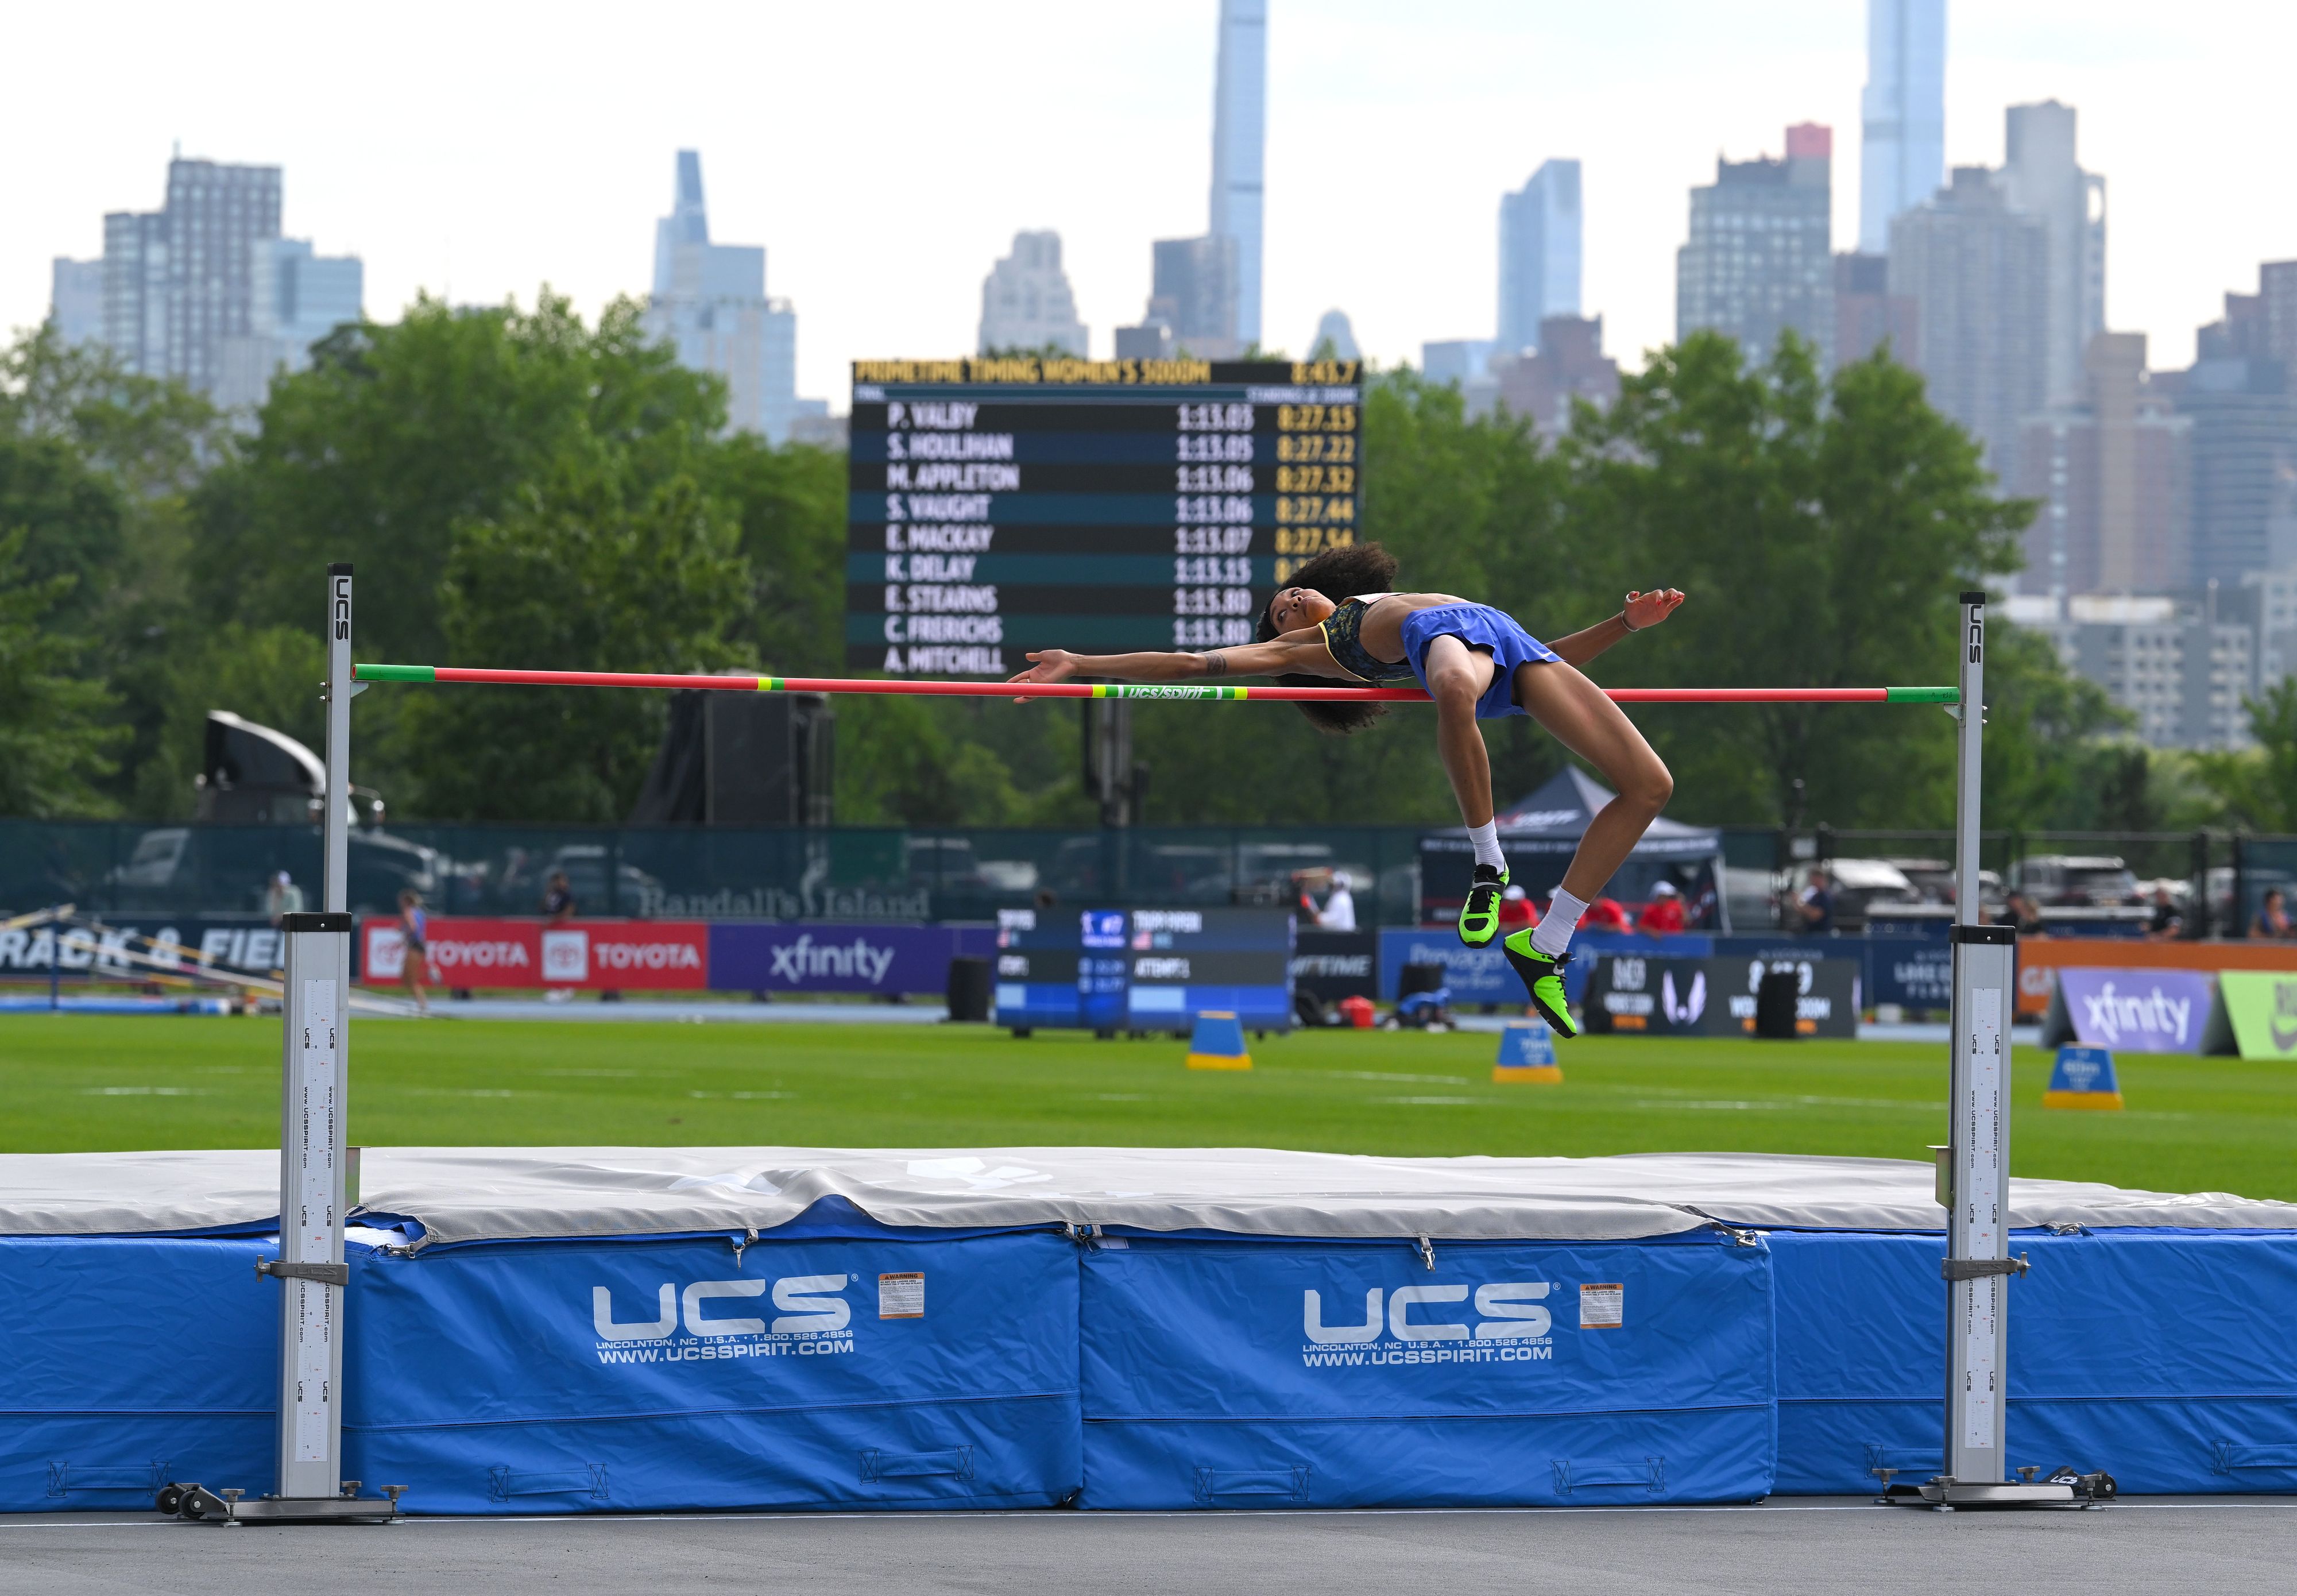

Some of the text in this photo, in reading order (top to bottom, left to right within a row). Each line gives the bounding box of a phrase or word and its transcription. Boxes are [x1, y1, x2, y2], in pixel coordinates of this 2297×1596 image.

[855, 359, 964, 383] PRIMETIME
[969, 358, 1040, 383] TIMING
[887, 401, 910, 430] P.
[910, 401, 979, 430] VALBY
[887, 432, 908, 459] S.
[887, 463, 914, 489] M.
[913, 463, 1020, 490] APPLETON
[886, 493, 907, 521] S.
[907, 494, 992, 521] VAUGHT
[886, 524, 907, 551] E.
[907, 524, 995, 551] MACKAY
[885, 554, 908, 581] K.
[909, 554, 976, 582] DELAY
[336, 579, 349, 640] UCS
[885, 585, 906, 612] E.
[907, 585, 998, 613] STEARNS
[884, 615, 906, 643] C.
[1969, 605, 1982, 664] UCS
[884, 645, 1007, 674] A. MITCHELL
[640, 887, 931, 918] Randall's Island
[425, 940, 529, 968] TOYOTA
[593, 942, 702, 969] TOYOTA
[769, 933, 895, 984] xfinity
[2083, 980, 2191, 1044] xfinity
[593, 1274, 851, 1342] UCS
[1304, 1282, 1552, 1344] UCS
[595, 1330, 853, 1350] LINCOLNTON, NC U.S.A. 1.800.526.4856
[597, 1339, 854, 1364] WWW.UCSSPIRIT.COM
[1302, 1343, 1381, 1352] LINCOLNTON,
[1408, 1340, 1444, 1348] U.S.A.
[1457, 1338, 1552, 1347] 1.800.526.4856
[1302, 1347, 1552, 1367] WWW.UCSSPIRIT.COM
[2050, 1475, 2078, 1485] UCS
